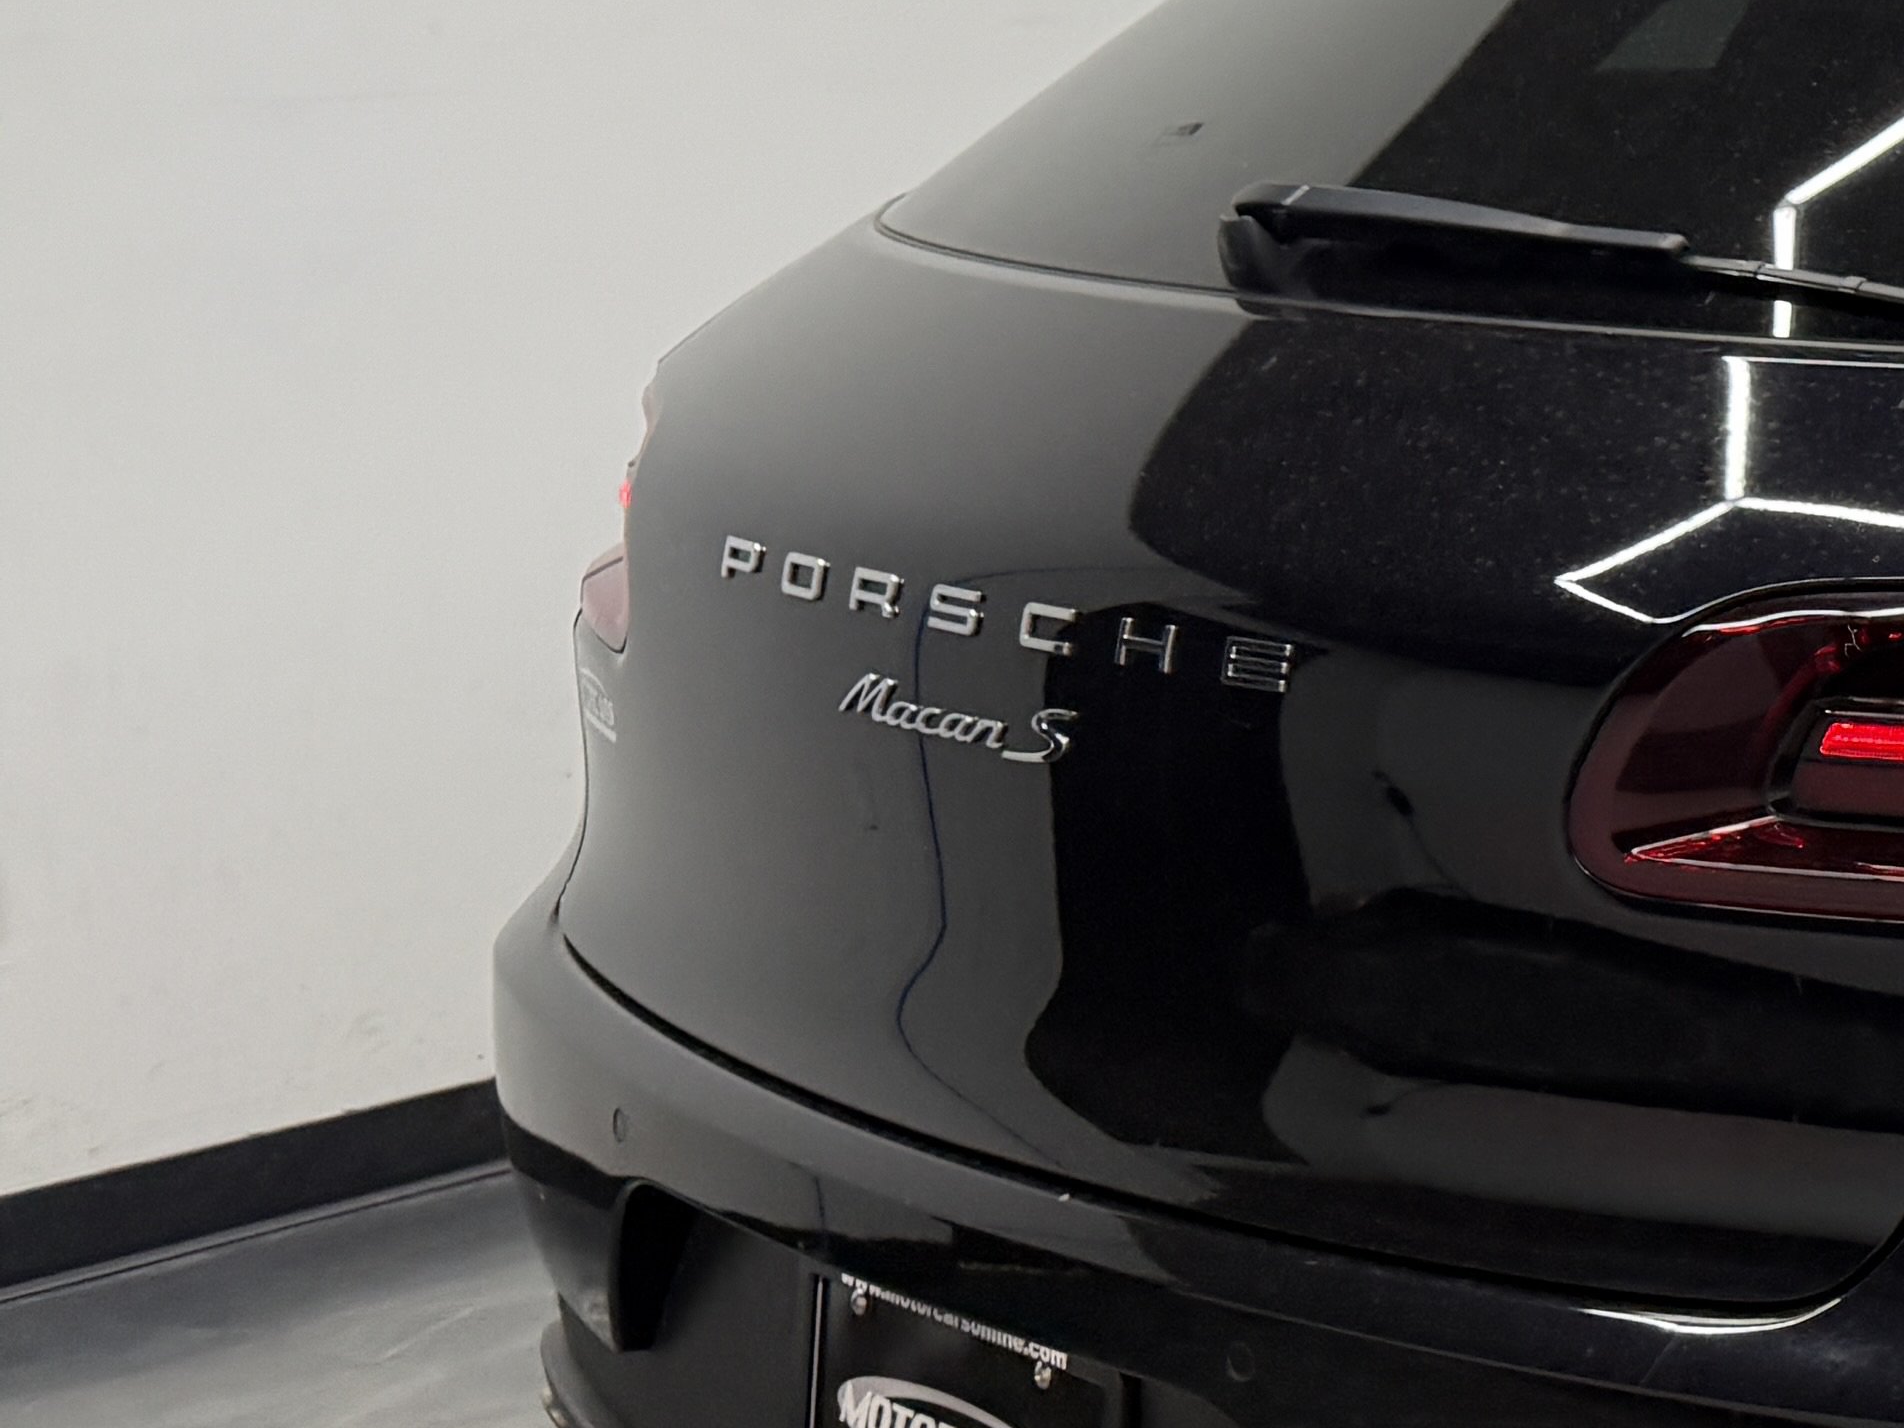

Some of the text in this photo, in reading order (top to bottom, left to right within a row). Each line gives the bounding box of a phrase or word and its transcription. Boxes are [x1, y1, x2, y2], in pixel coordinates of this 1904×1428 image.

[721, 535, 1295, 693] PORSCHE
[838, 672, 1078, 763] Macan S
